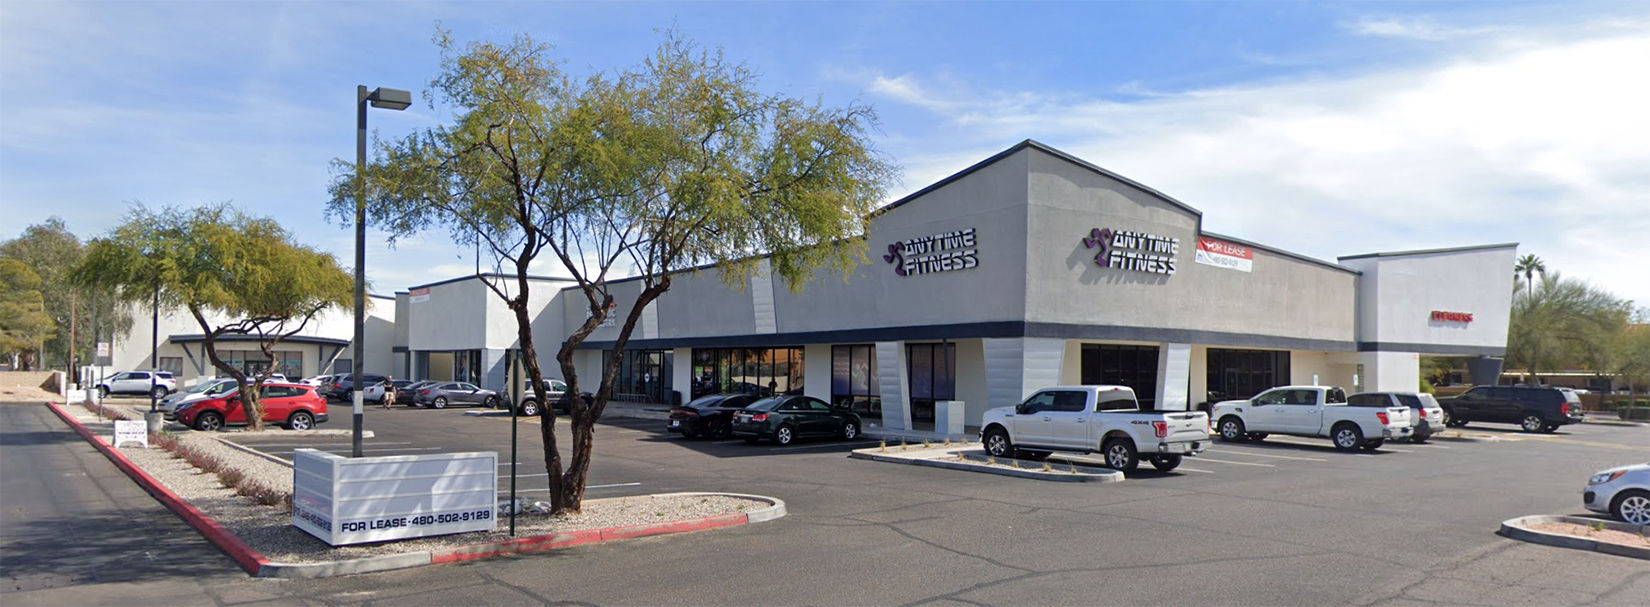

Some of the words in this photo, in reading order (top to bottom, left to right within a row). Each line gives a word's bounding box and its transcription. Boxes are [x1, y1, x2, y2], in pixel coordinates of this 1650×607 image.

[905, 228, 976, 256] ANYTIME
[1110, 230, 1179, 254] ANYTIME
[1206, 241, 1223, 252] FOR
[1223, 245, 1246, 257] LEASE
[905, 249, 979, 276] FITNESS
[1107, 250, 1177, 275] FITNESS
[341, 521, 367, 532] FOR
